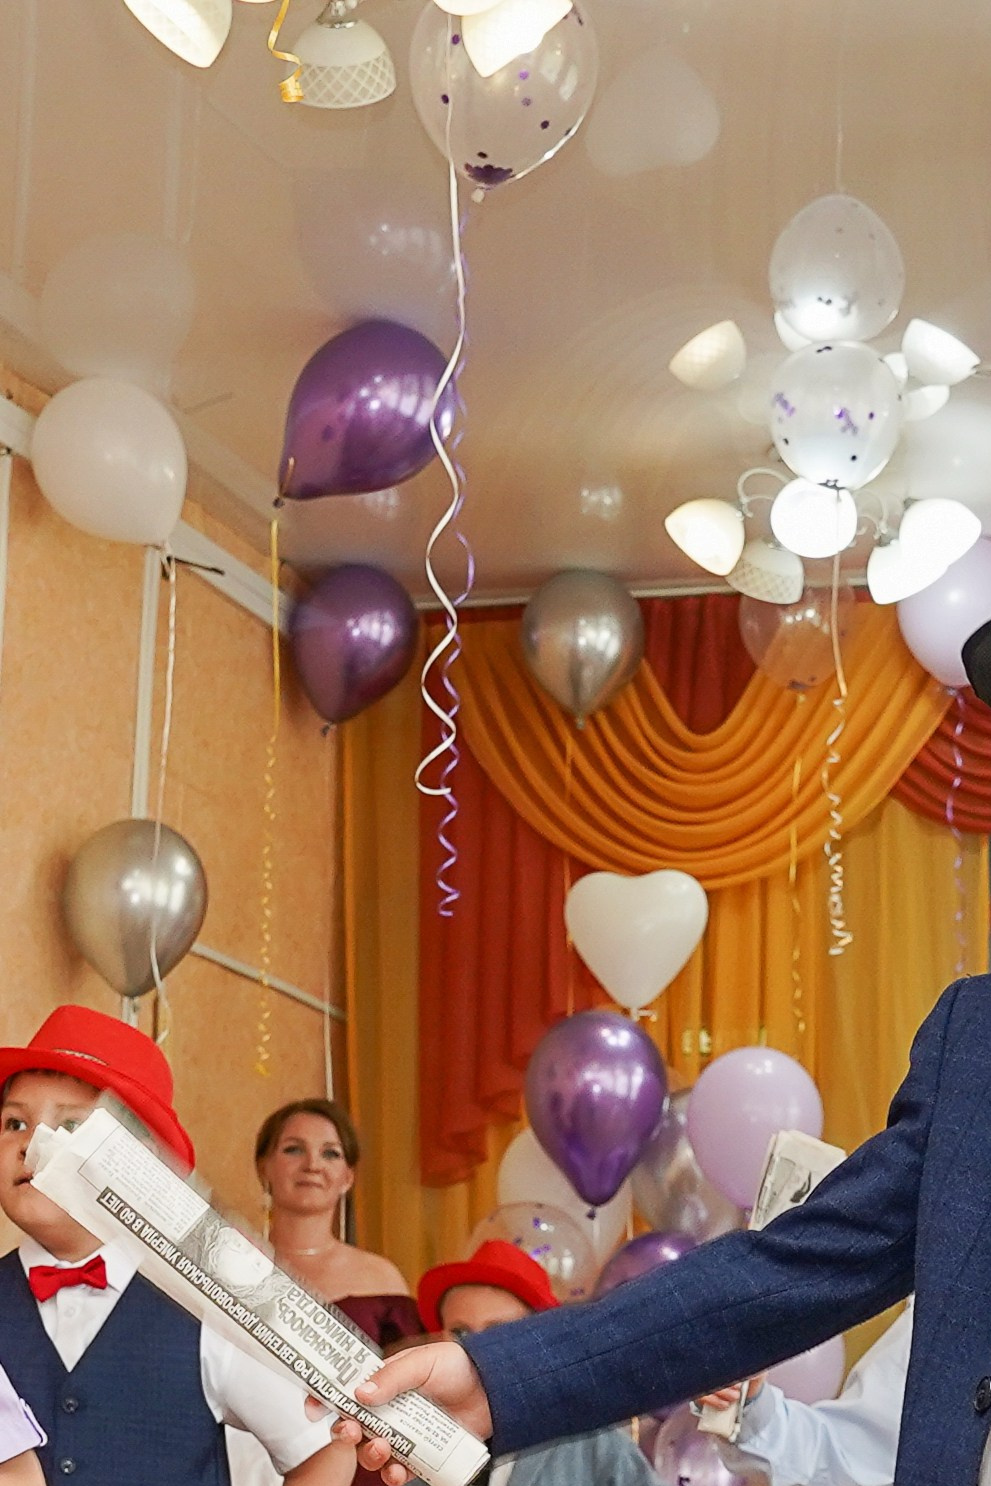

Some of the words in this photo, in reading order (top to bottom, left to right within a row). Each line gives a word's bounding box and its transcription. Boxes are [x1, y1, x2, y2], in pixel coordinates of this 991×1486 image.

[99, 1189, 125, 1214] ЛЕТ
[117, 1205, 137, 1225] 60
[129, 1215, 145, 1232] В
[138, 1223, 182, 1264] УМЕРЛА
[175, 1254, 260, 1330] ДОБРОВОЛЬСКАЯ
[282, 1284, 358, 1352] никогда
[251, 1320, 299, 1364] ЕВГЕНИЯ
[272, 1295, 359, 1387] Признаюсь,
[353, 1346, 371, 1364] я
[291, 1355, 315, 1378] РФ
[307, 1369, 361, 1415] АРТИСТКА
[357, 1408, 412, 1455] НАРОДНАЯ
